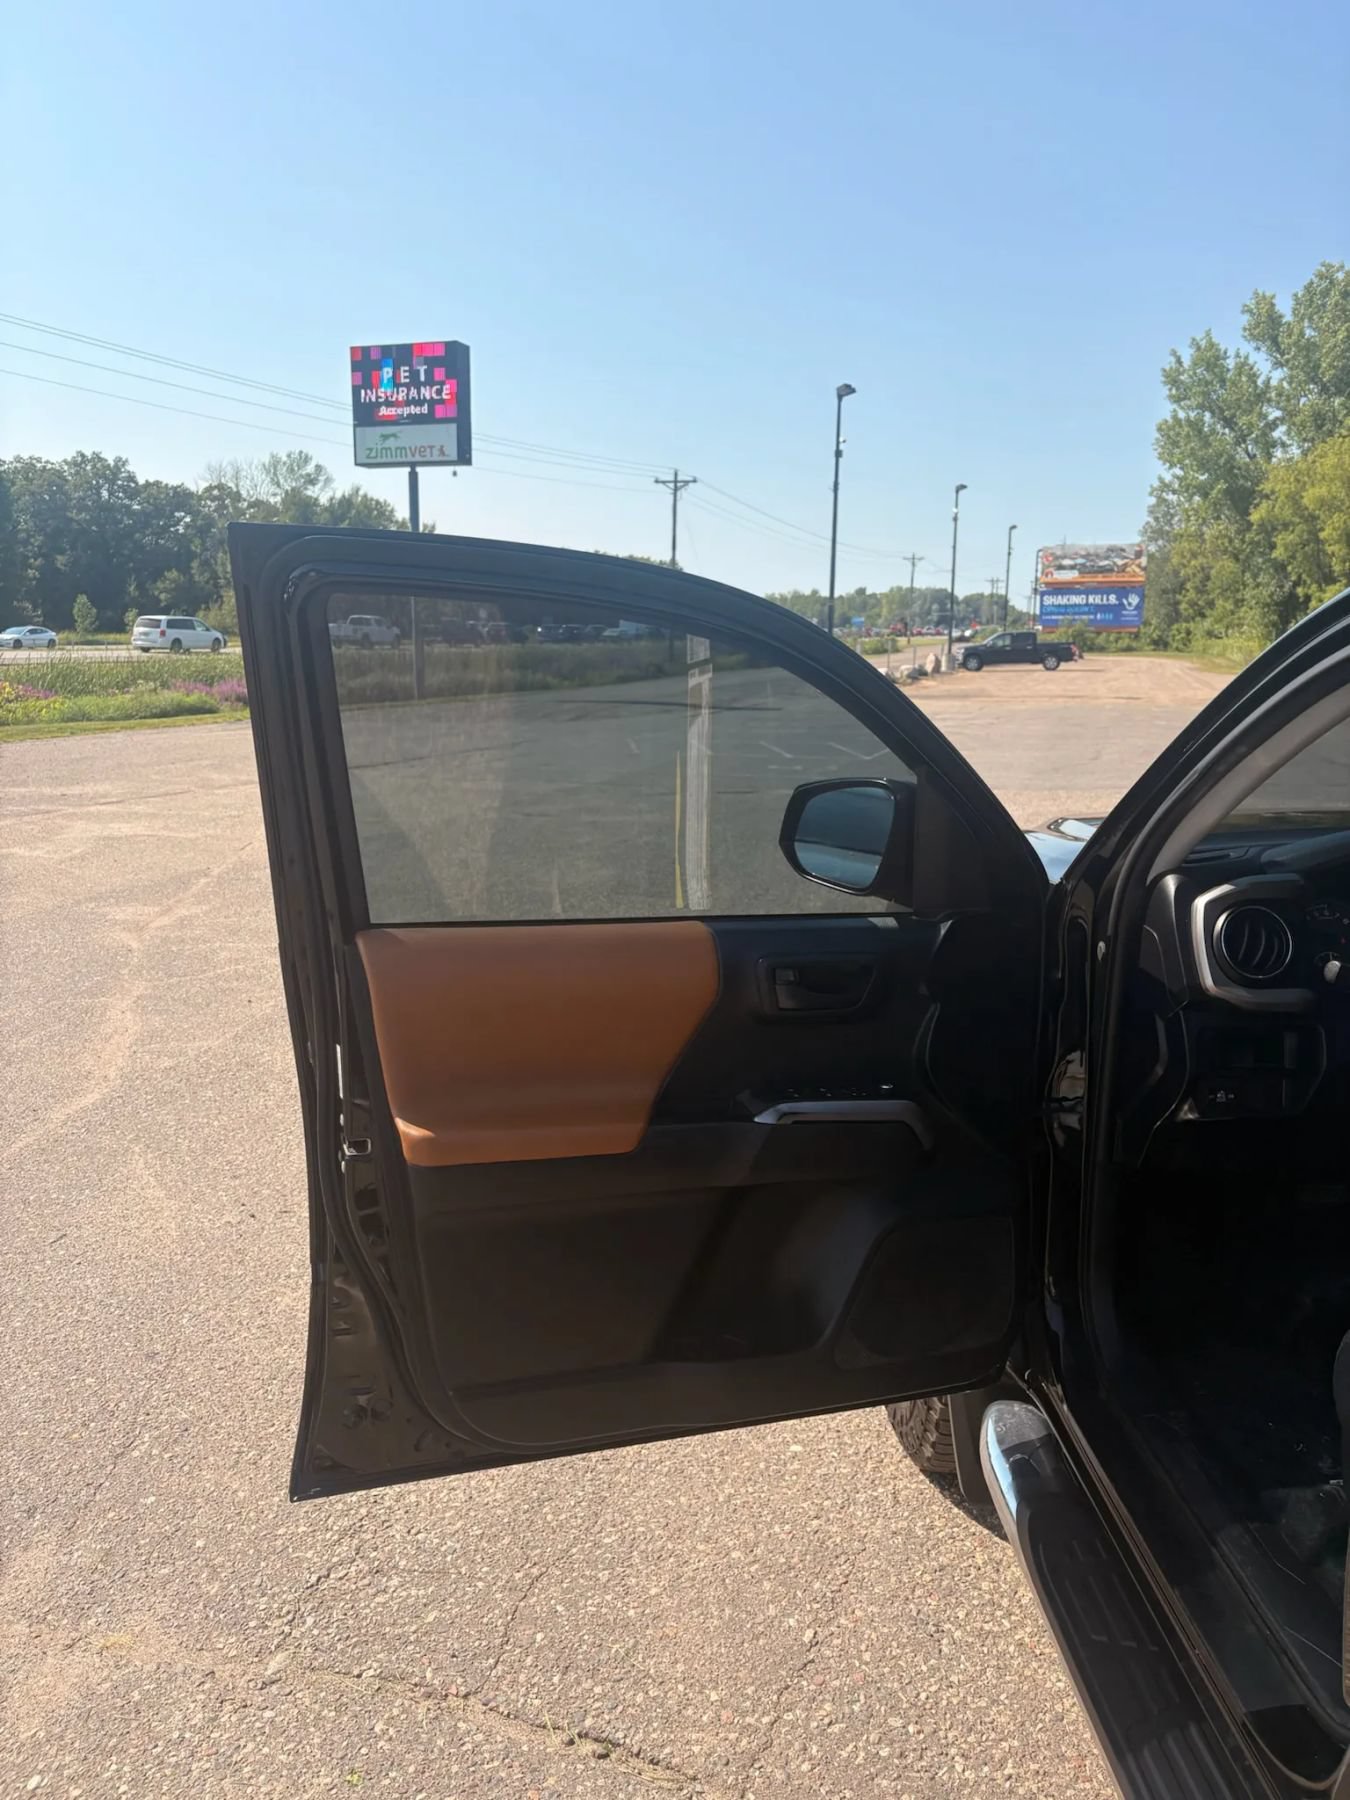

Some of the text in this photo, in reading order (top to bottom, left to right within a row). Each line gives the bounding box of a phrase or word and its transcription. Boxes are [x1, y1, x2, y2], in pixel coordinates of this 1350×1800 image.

[382, 365, 428, 383] PET
[361, 384, 451, 403] INSURANCE
[378, 403, 428, 417] Accepted
[1042, 593, 1119, 606] SHAKING KILLS.
